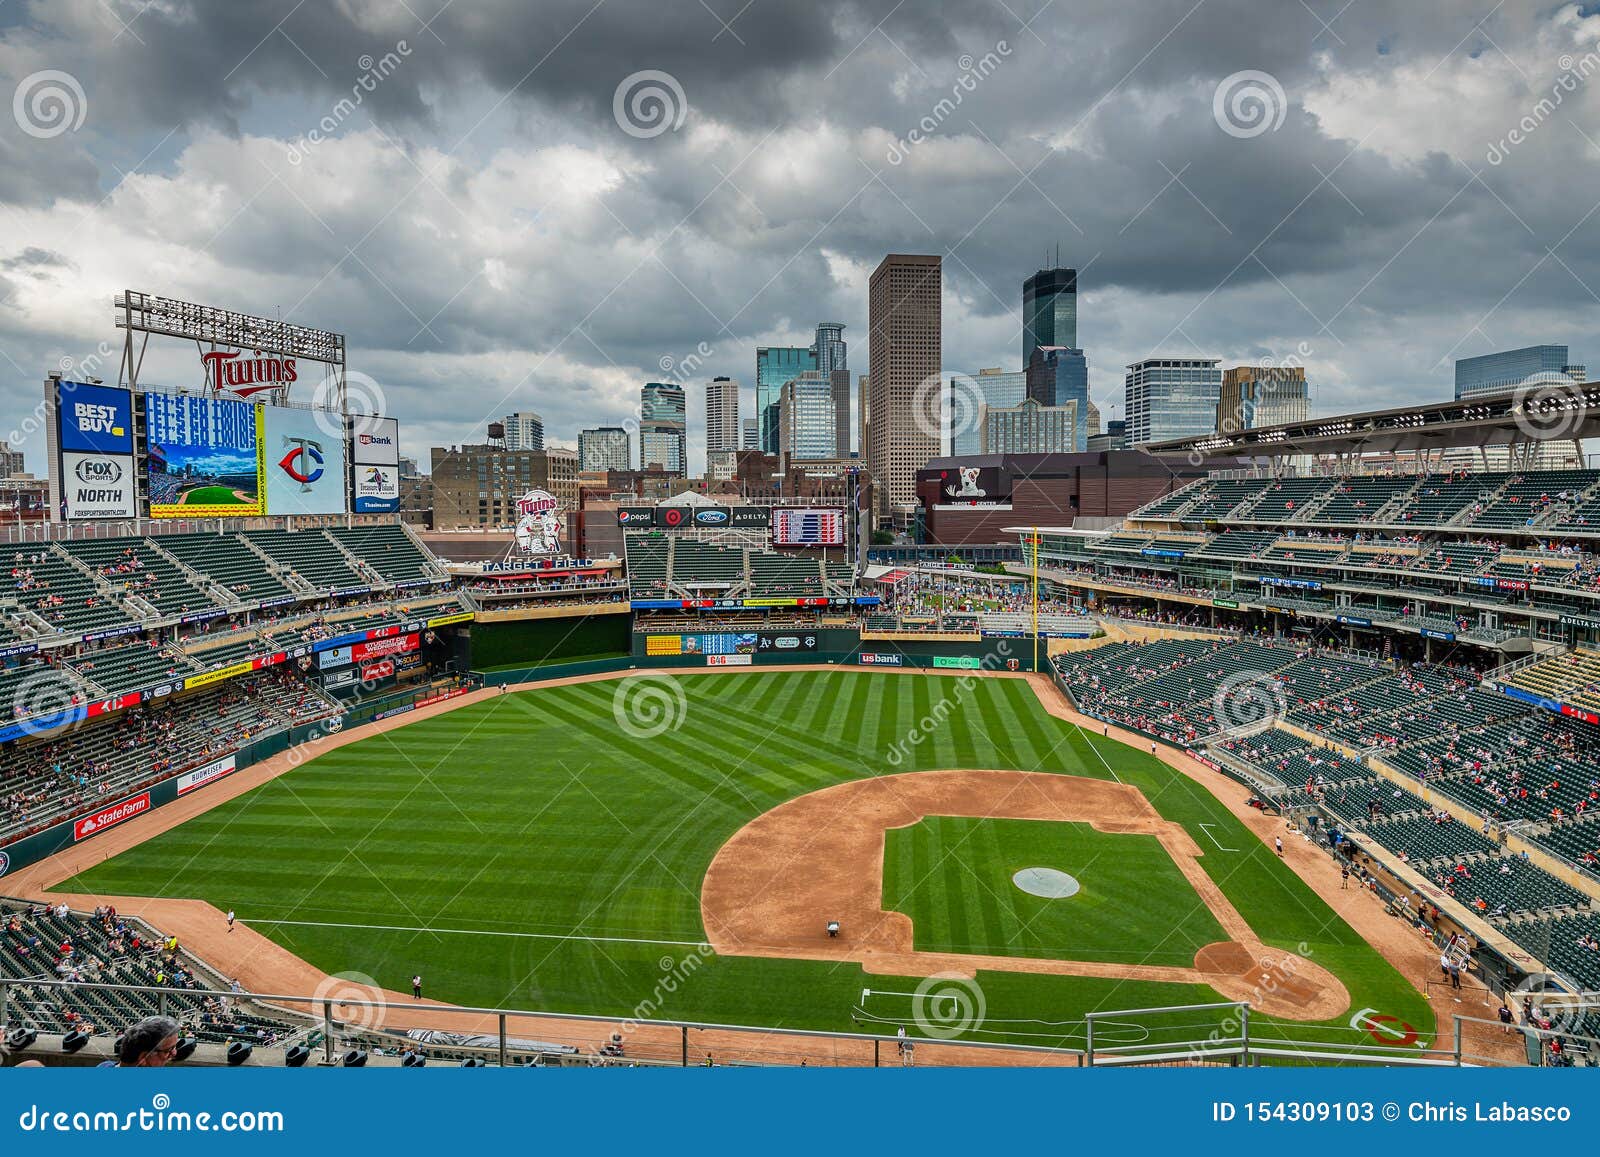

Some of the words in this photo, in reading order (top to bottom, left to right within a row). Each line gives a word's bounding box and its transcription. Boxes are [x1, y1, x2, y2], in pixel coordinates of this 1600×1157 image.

[203, 349, 298, 392] Twins
[75, 403, 117, 420] BEST
[78, 417, 114, 433] BUY
[85, 462, 113, 475] FOX
[77, 488, 122, 503] NORTH
[517, 497, 557, 516] Twins
[630, 513, 650, 521] pepsi
[482, 561, 541, 571] TARGET
[555, 558, 594, 568] FIELD
[1567, 617, 1589, 628] DELTA
[128, 626, 141, 634] Porch
[7, 648, 18, 656] Run
[19, 646, 35, 654] Porch
[862, 654, 900, 664] usbank
[191, 762, 223, 782] BUDWEISER
